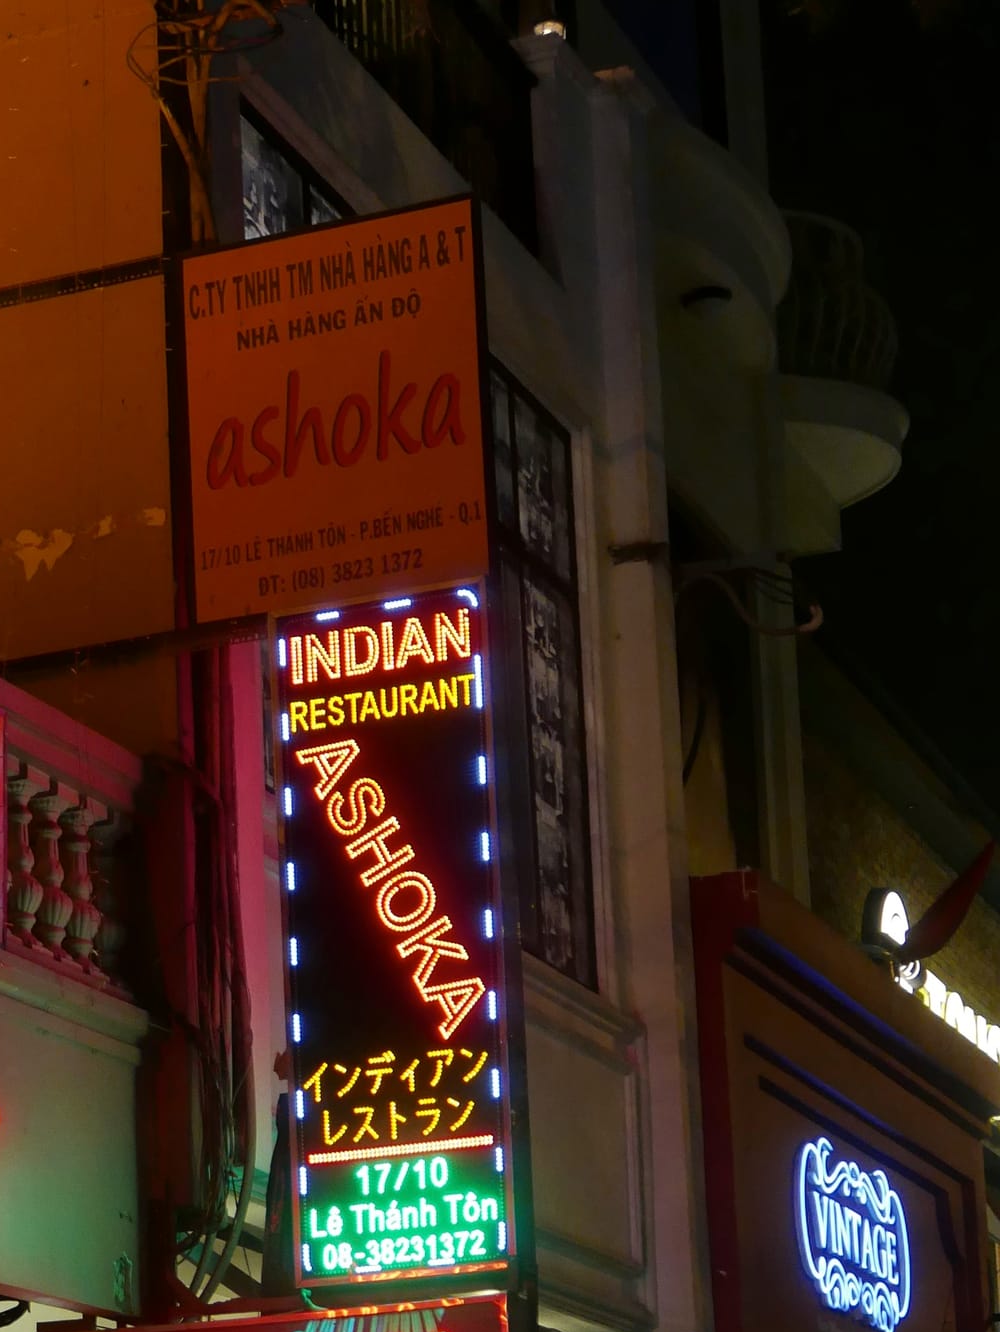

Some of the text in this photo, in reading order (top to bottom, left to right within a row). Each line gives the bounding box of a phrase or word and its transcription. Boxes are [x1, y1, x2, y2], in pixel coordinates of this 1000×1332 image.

[189, 226, 466, 320] C.TY TNHH TM NHÀ HÀNG A & T
[236, 288, 421, 351] NHÀ HÀNG ẤN ĐỘ
[206, 349, 466, 490] ashoka
[201, 544, 241, 571] 17/10
[291, 565, 326, 592] (08)
[332, 557, 374, 583] 3823
[381, 548, 424, 575] 1372
[290, 608, 473, 686] INDIAN
[290, 673, 476, 734] RESTAURANT
[296, 739, 485, 1040] ASHOKA
[304, 1047, 488, 1102] インディアン
[323, 1097, 475, 1145] レストラン
[356, 1156, 449, 1195] 17/10
[310, 1191, 499, 1239] Lê Thánh Tôn
[813, 1191, 899, 1285] VINTAGE
[322, 1230, 487, 1270] 08-38231372
